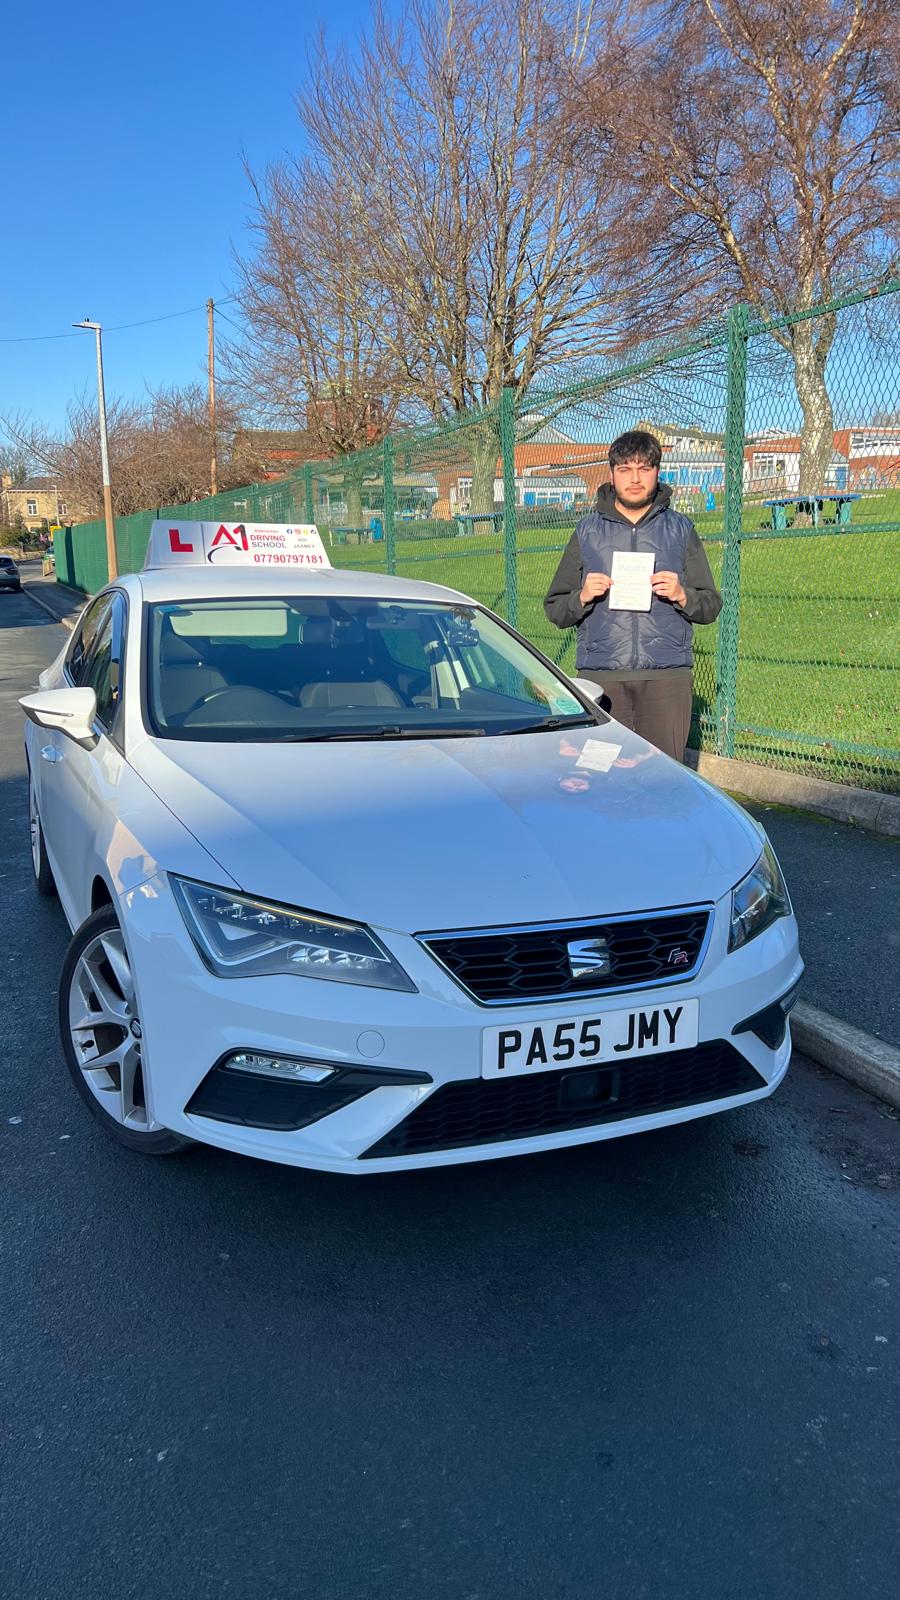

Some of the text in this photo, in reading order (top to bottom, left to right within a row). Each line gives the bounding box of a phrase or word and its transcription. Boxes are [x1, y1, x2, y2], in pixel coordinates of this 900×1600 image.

[169, 529, 194, 552] L
[211, 524, 249, 551] A1
[250, 534, 286, 542] DRIVING
[251, 541, 287, 549] SCHOOL
[254, 554, 323, 564] 07790797181
[497, 1006, 684, 1070] PA55 JMY
